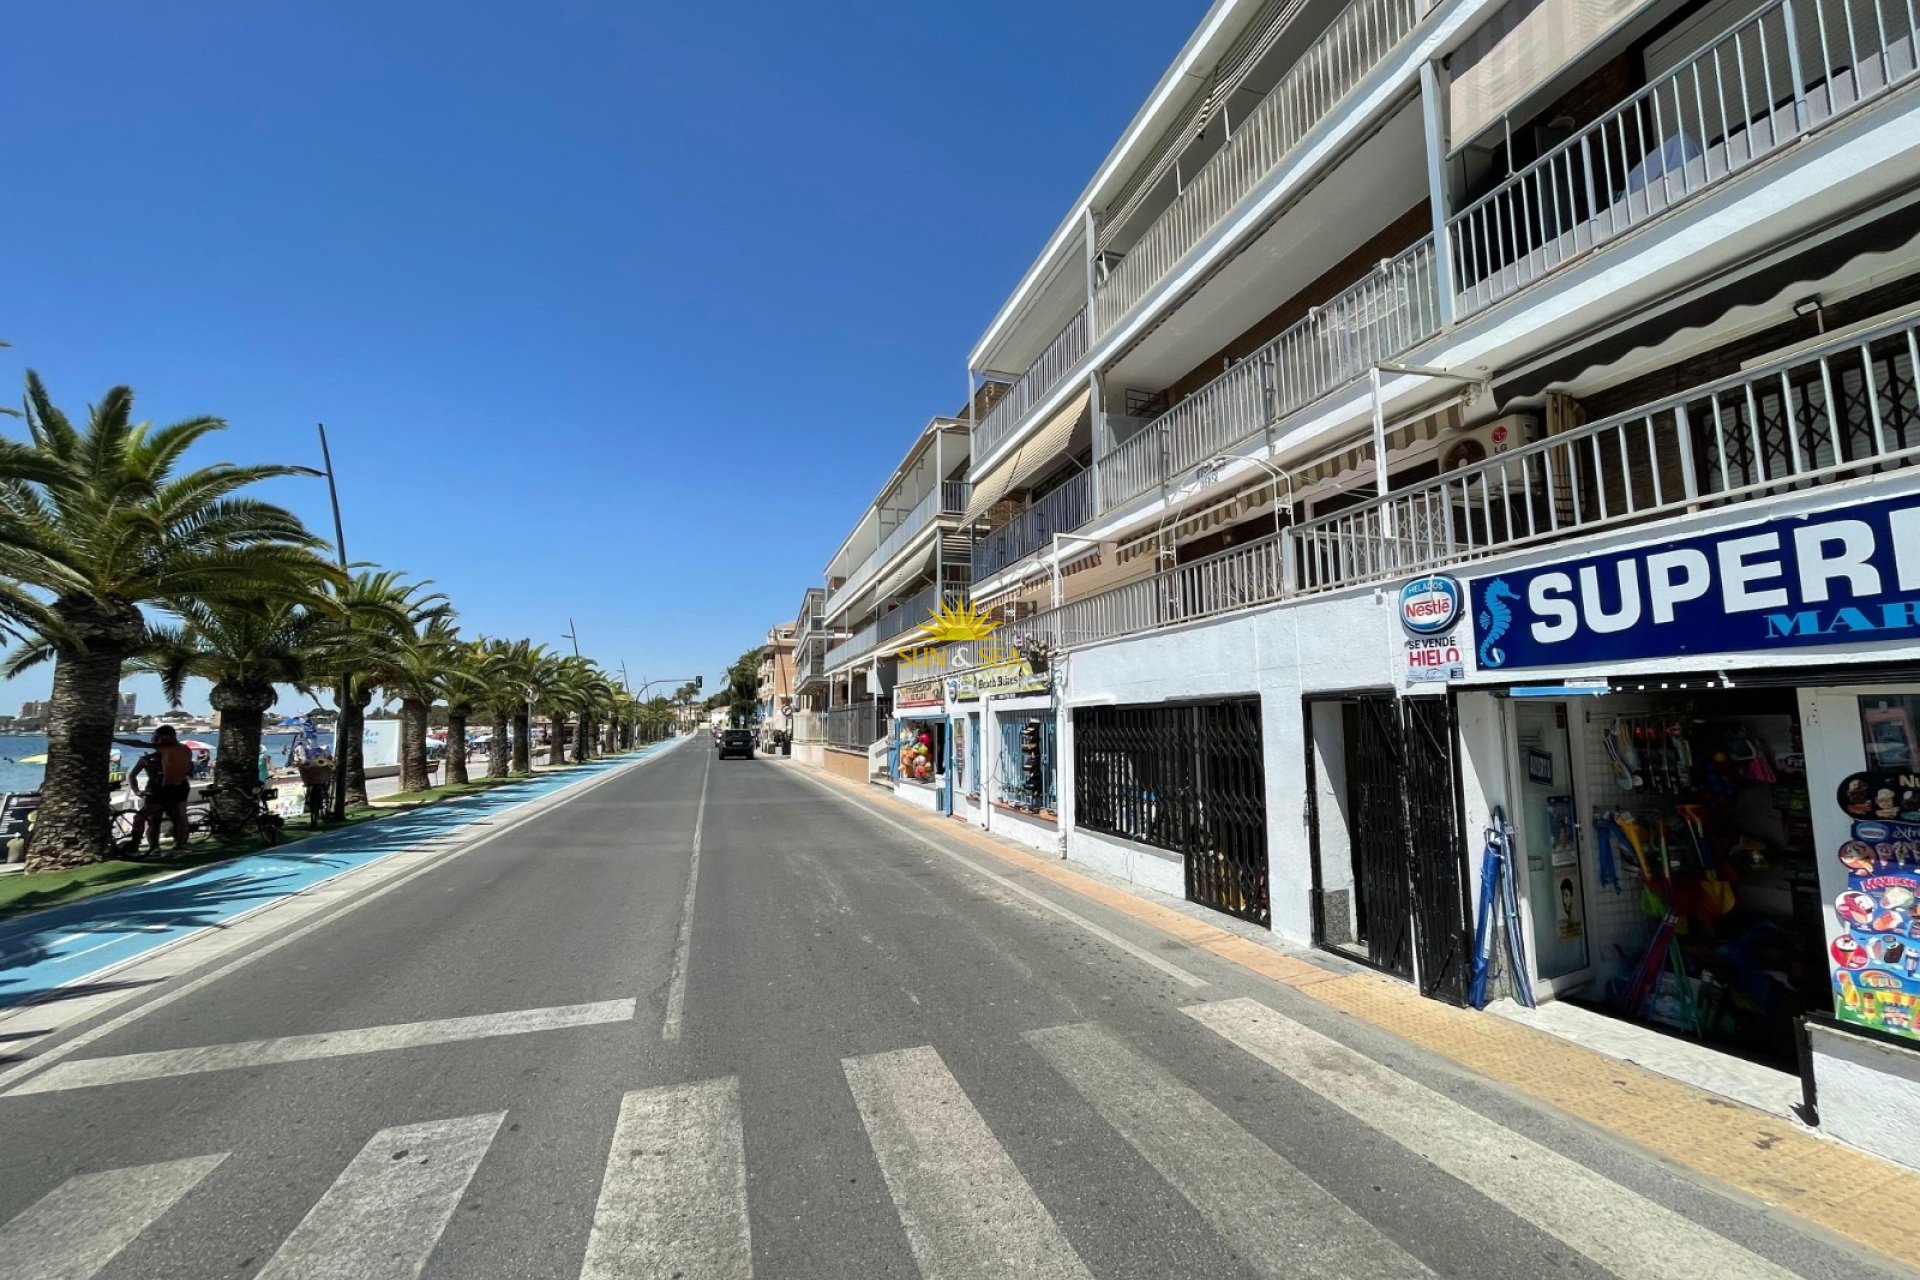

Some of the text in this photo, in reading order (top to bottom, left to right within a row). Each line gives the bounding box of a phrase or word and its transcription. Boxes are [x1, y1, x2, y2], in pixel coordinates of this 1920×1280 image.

[1494, 443, 1507, 454] LG
[1408, 636, 1456, 650] SE VENDE
[1409, 647, 1460, 667] HIELO
